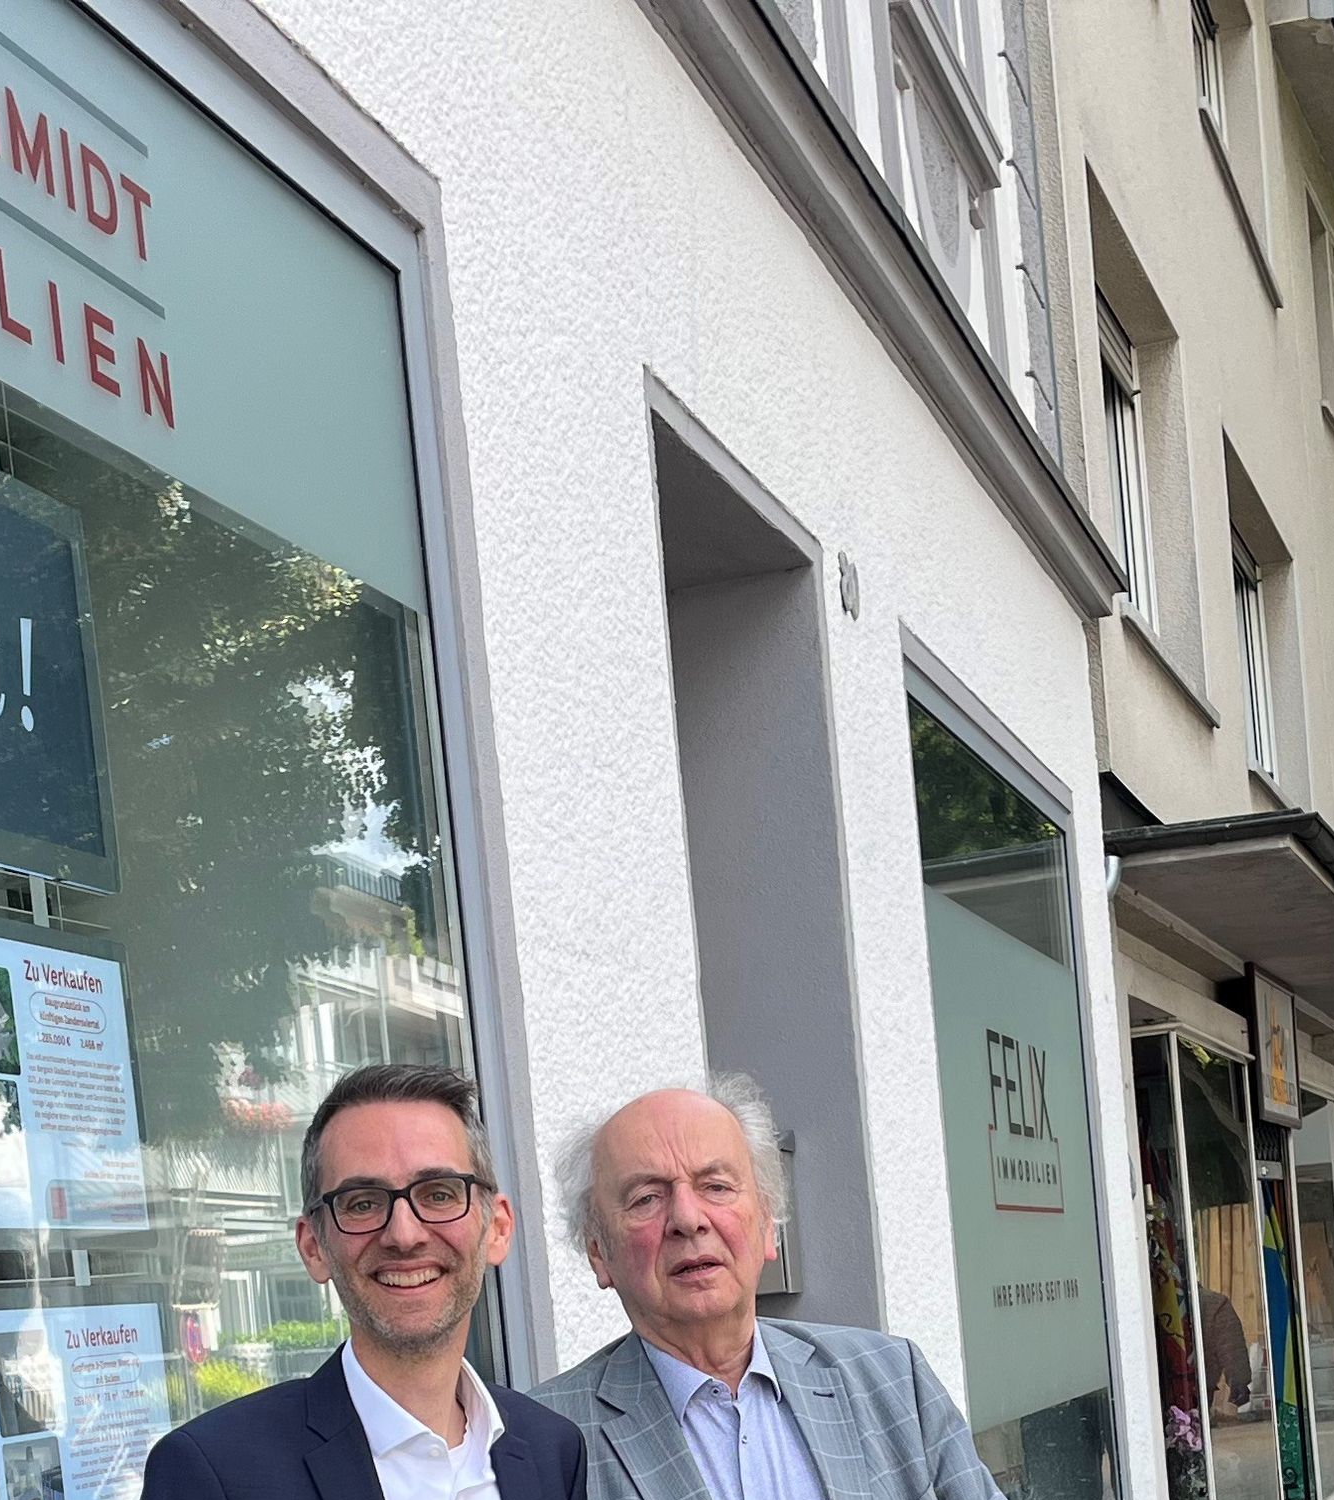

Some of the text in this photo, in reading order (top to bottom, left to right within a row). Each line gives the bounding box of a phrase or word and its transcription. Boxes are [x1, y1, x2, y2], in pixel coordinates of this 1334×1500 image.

[23, 958, 104, 995] Zu Verkaufen
[985, 1028, 1054, 1142] FELIX
[996, 1155, 1058, 1185] IMMOBILIEN
[992, 1284, 1014, 1309] IHRE
[1015, 1281, 1044, 1306] PROFIS
[1044, 1279, 1062, 1302] SEIT
[64, 1323, 139, 1350] Zu Verkaufen
